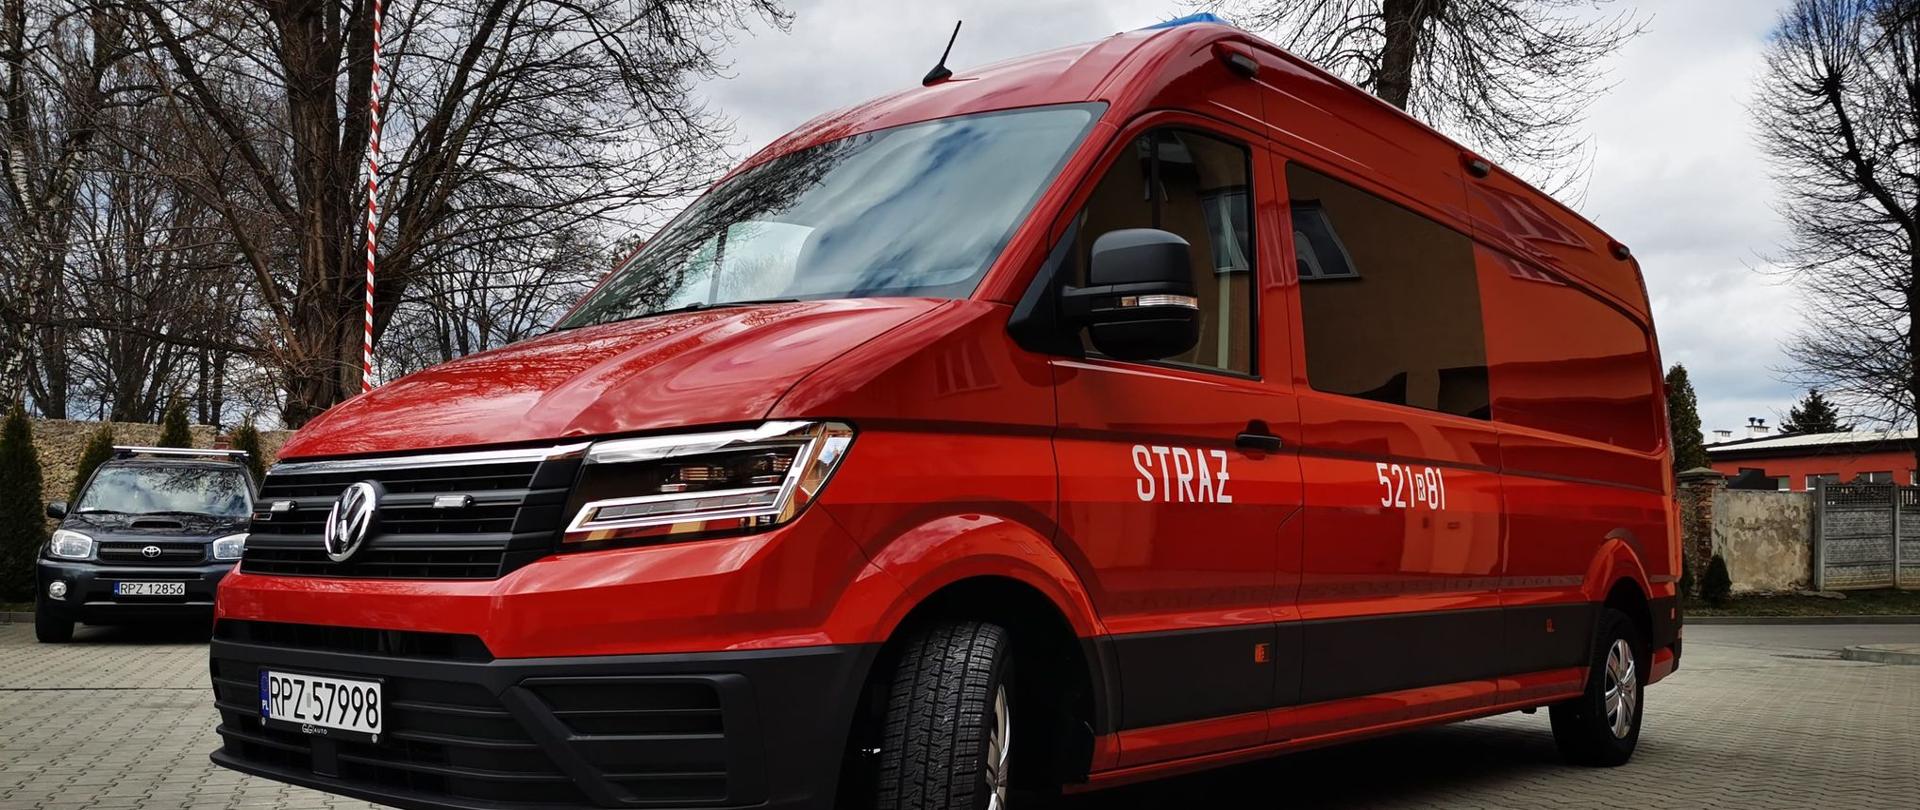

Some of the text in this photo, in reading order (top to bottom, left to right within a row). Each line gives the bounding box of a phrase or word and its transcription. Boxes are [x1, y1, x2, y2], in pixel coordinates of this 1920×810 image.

[121, 583, 143, 594] RPZ
[149, 583, 183, 594] 12856
[262, 699, 269, 711] PL
[270, 676, 379, 729] RPZ 57998
